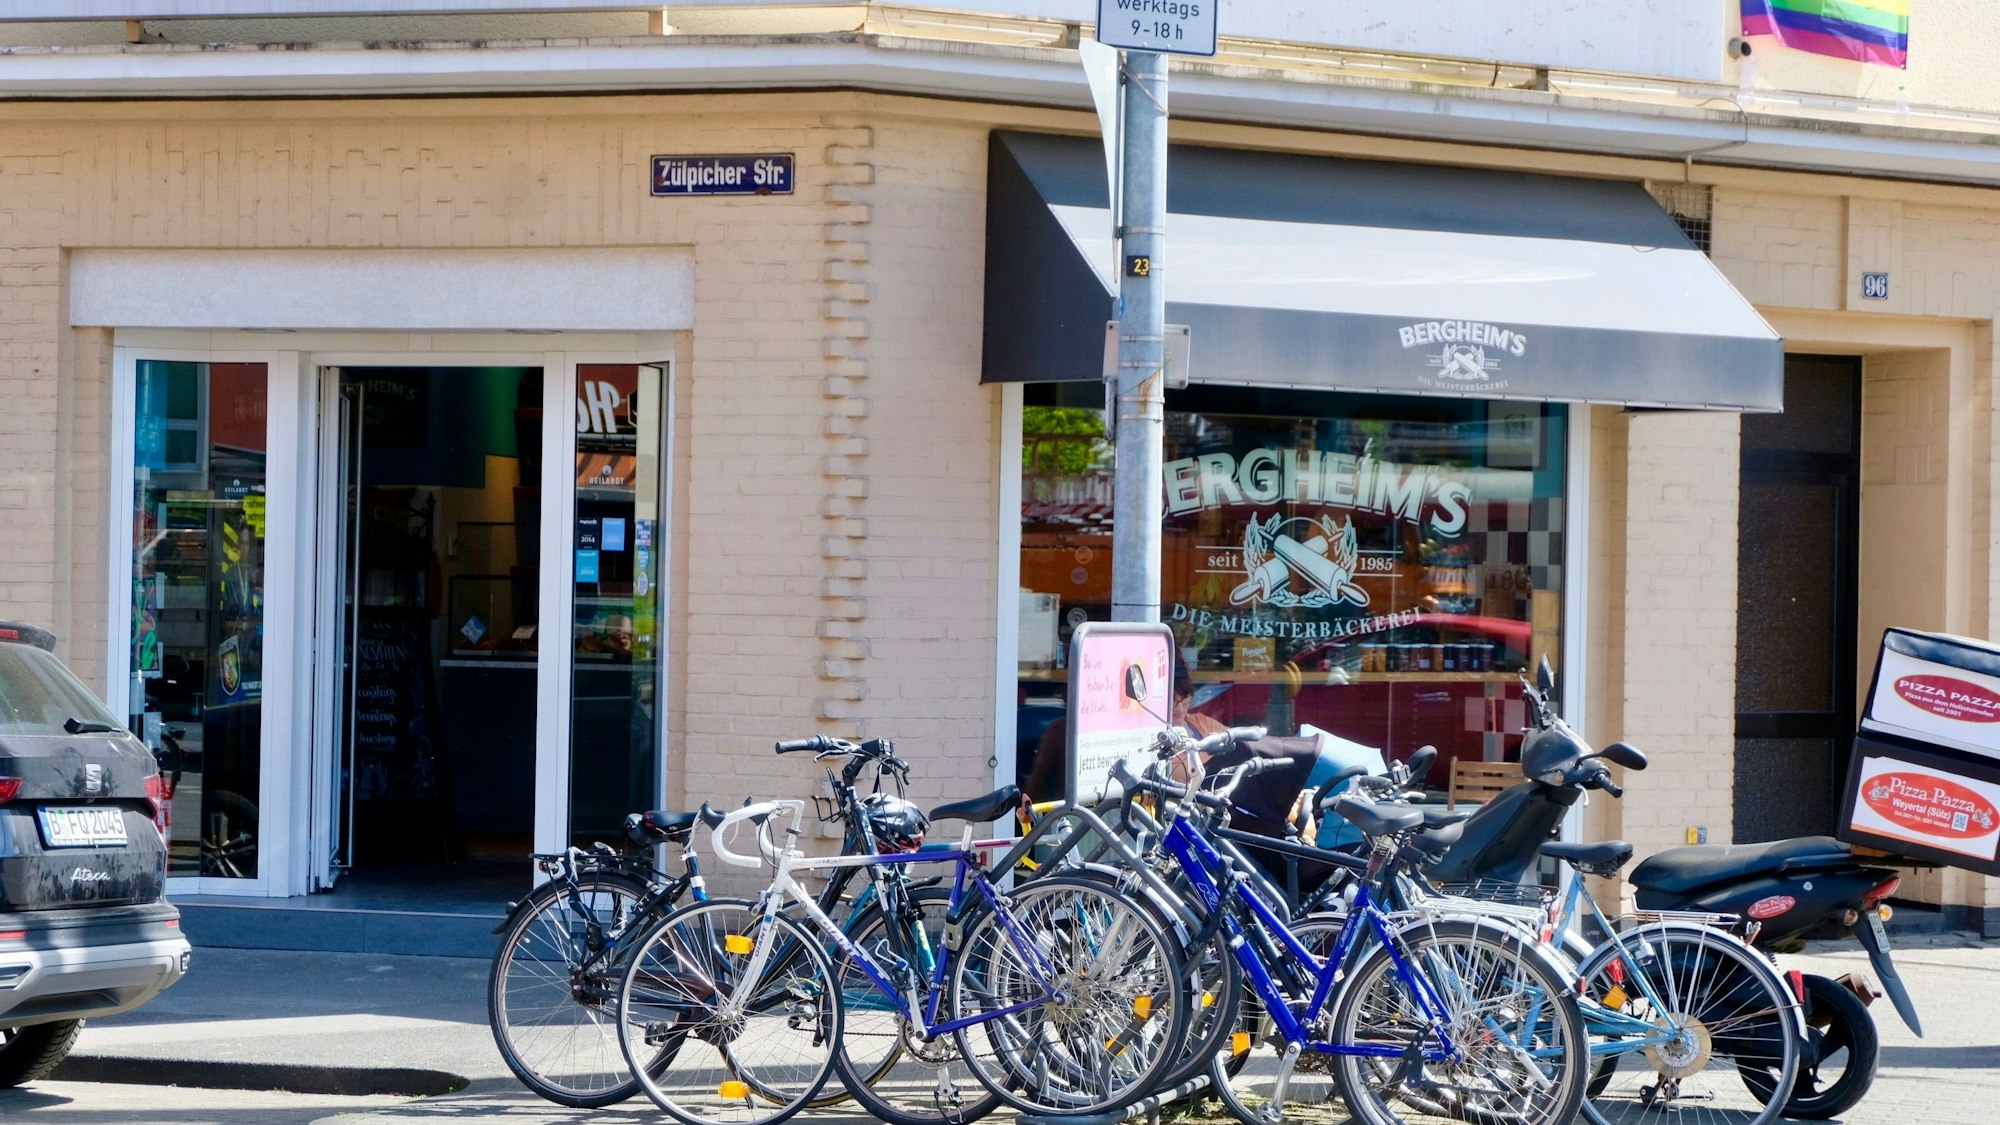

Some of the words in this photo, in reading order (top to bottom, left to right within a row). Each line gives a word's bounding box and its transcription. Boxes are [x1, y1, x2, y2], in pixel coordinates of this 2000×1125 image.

[1175, 23, 1183, 40] h
[658, 159, 747, 193] Zülpicher
[753, 158, 785, 186] Str.
[1134, 258, 1149, 273] 23
[1865, 275, 1886, 297] 96
[1398, 320, 1528, 357] BERGHEIM'S
[1417, 375, 1433, 387] DIE
[1161, 447, 1475, 539] ERGHEIM'S
[1207, 551, 1239, 568] seit
[1360, 557, 1394, 572] 1985
[1171, 602, 1214, 627] DIE
[1219, 606, 1423, 639] MEISTERBÄCKEREI
[1899, 680, 1946, 698] PIZZA
[1950, 692, 2000, 711] PAZZA
[1904, 691, 1922, 701] Pizza
[1934, 698, 1949, 708] dem
[1949, 702, 1994, 718] Holzsteinofen
[1932, 705, 1945, 713] seit
[1945, 708, 1962, 717] 2001
[1079, 755, 1097, 775] Jetzt
[1889, 777, 1928, 801] Pizza
[1931, 787, 1976, 813] Pazza
[1891, 797, 1926, 815] Weyertal
[1927, 806, 1952, 821] (Sülz)
[48, 810, 61, 835] B
[67, 810, 90, 835] FQ
[90, 810, 125, 835] 2045
[70, 867, 111, 882] Ateca
[755, 926, 768, 957] GIANT
